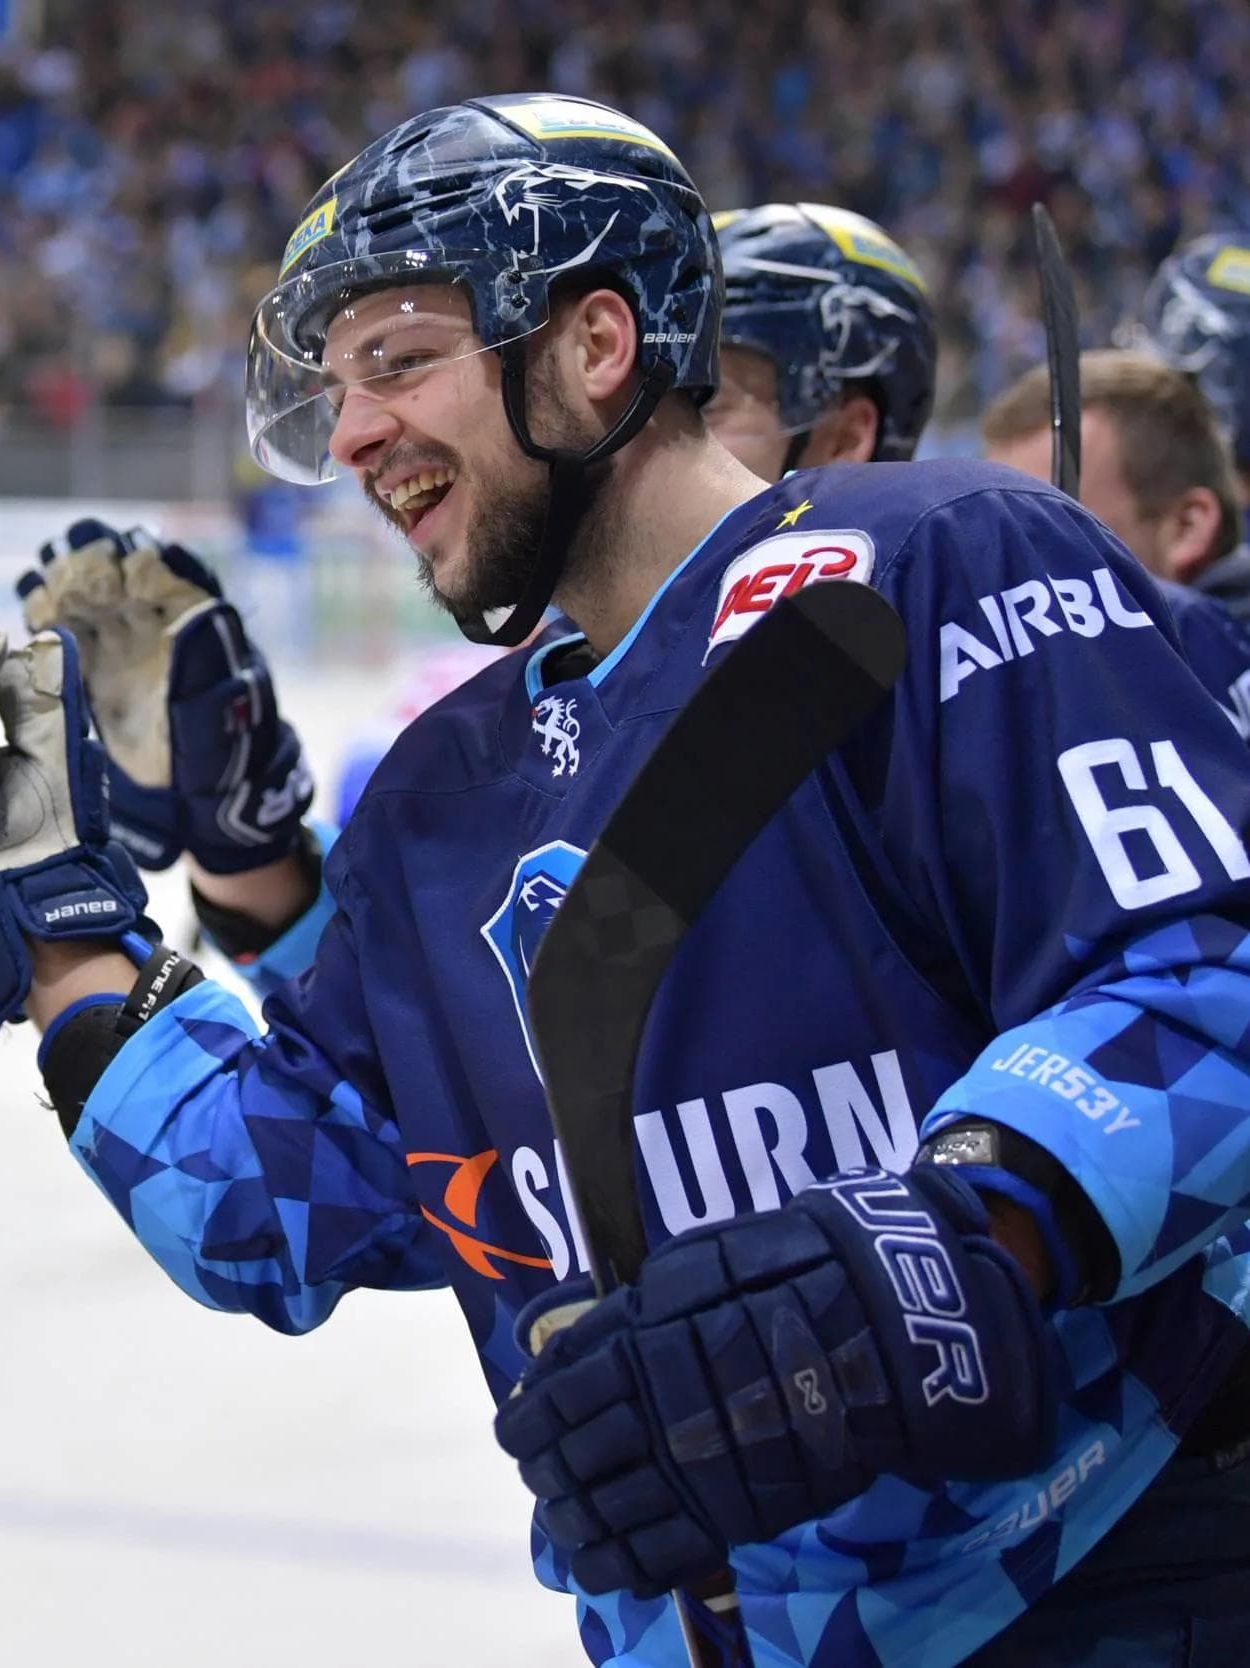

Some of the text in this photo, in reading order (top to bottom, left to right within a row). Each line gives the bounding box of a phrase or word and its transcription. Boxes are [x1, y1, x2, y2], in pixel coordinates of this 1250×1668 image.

[642, 332, 698, 344] BAUER
[1057, 738, 1250, 911] 61
[44, 899, 118, 923] BAUER
[151, 954, 180, 994] TUNE
[510, 1048, 923, 1282] SURN
